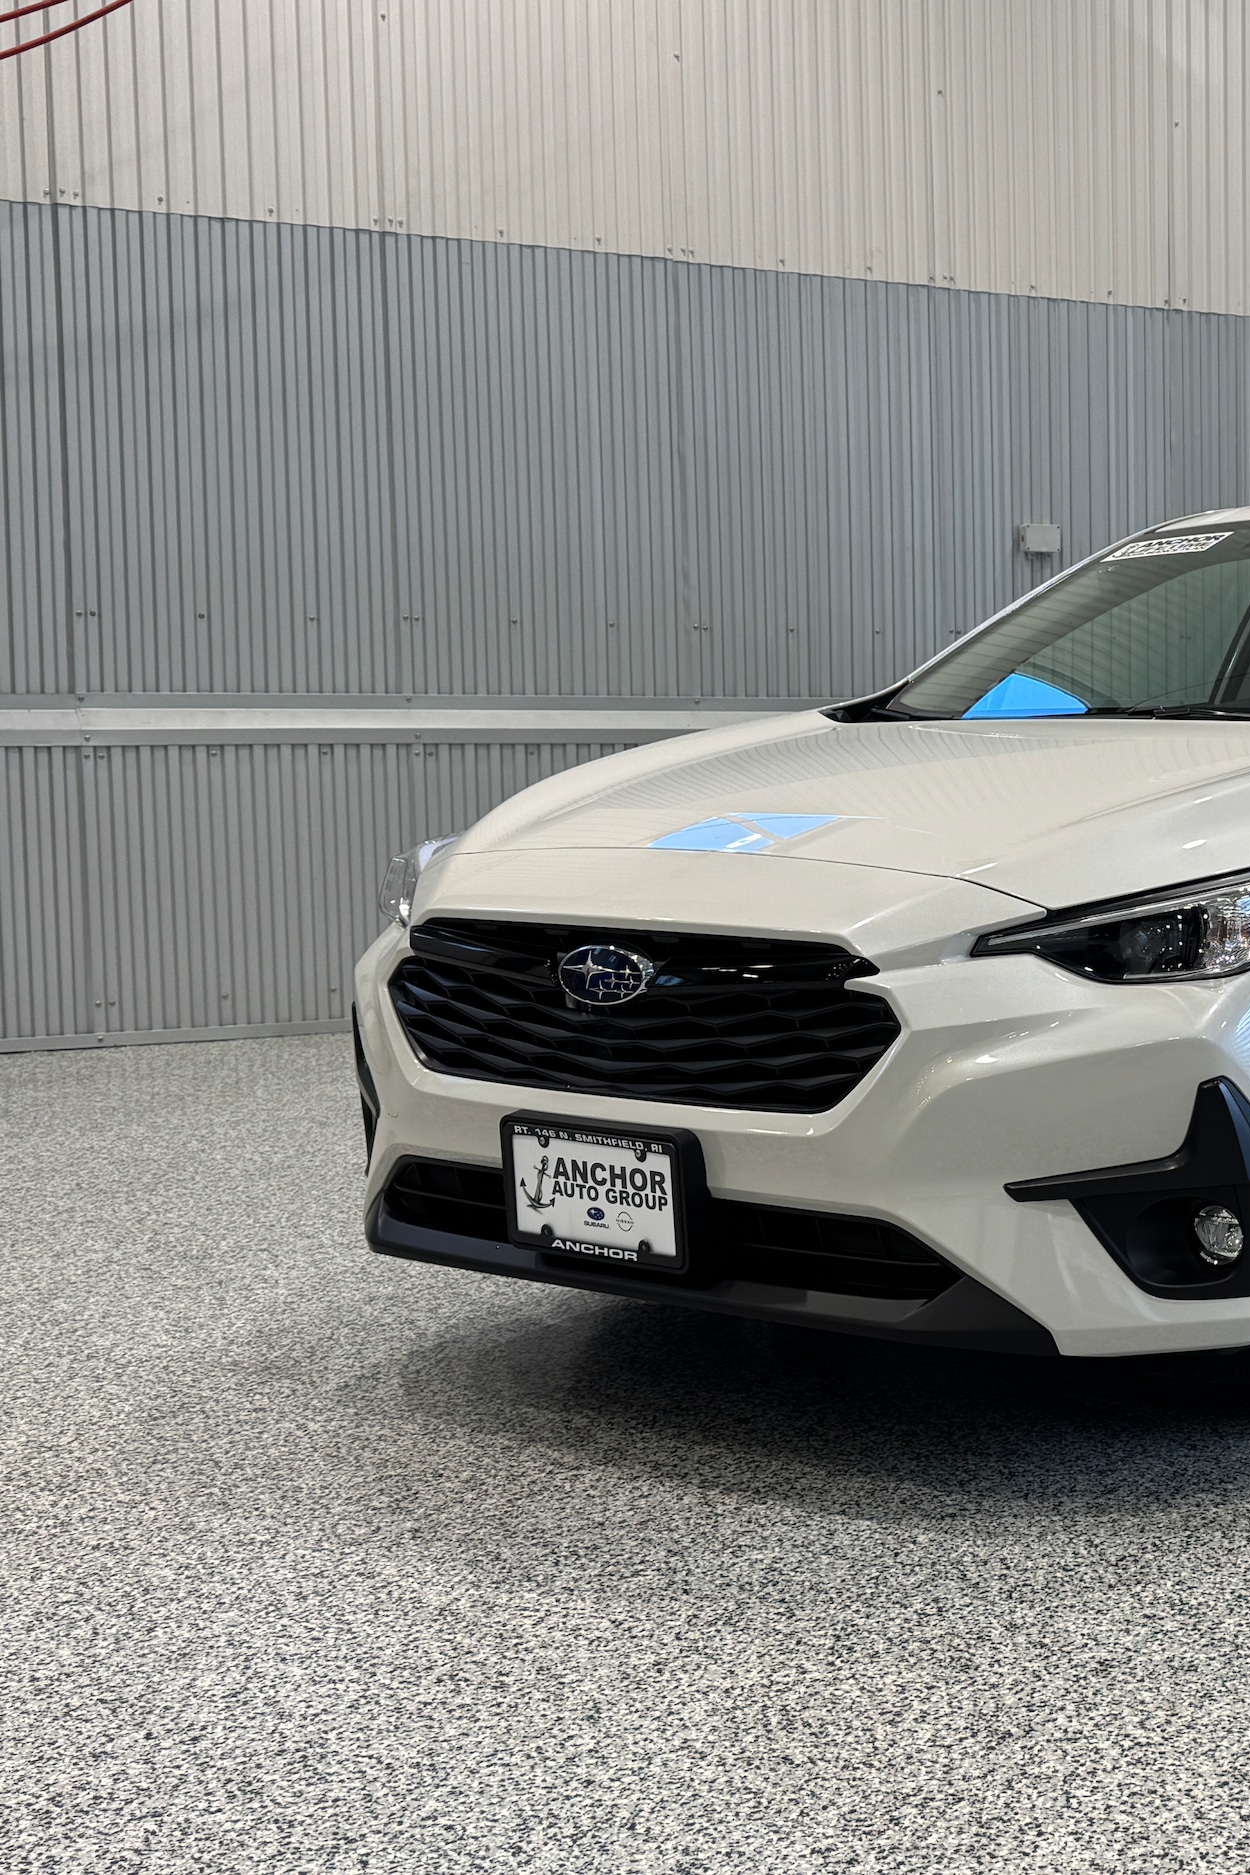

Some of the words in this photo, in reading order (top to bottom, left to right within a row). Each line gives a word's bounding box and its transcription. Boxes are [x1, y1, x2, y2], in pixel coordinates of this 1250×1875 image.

[513, 1125, 532, 1136] RT.
[534, 1128, 557, 1138] 146
[559, 1132, 572, 1141] N.
[651, 1143, 663, 1153] RI
[552, 1157, 668, 1196] ANCHOR
[551, 1180, 599, 1202] AUTO
[605, 1188, 668, 1212] GROUP
[551, 1239, 638, 1262] ANCHOR
